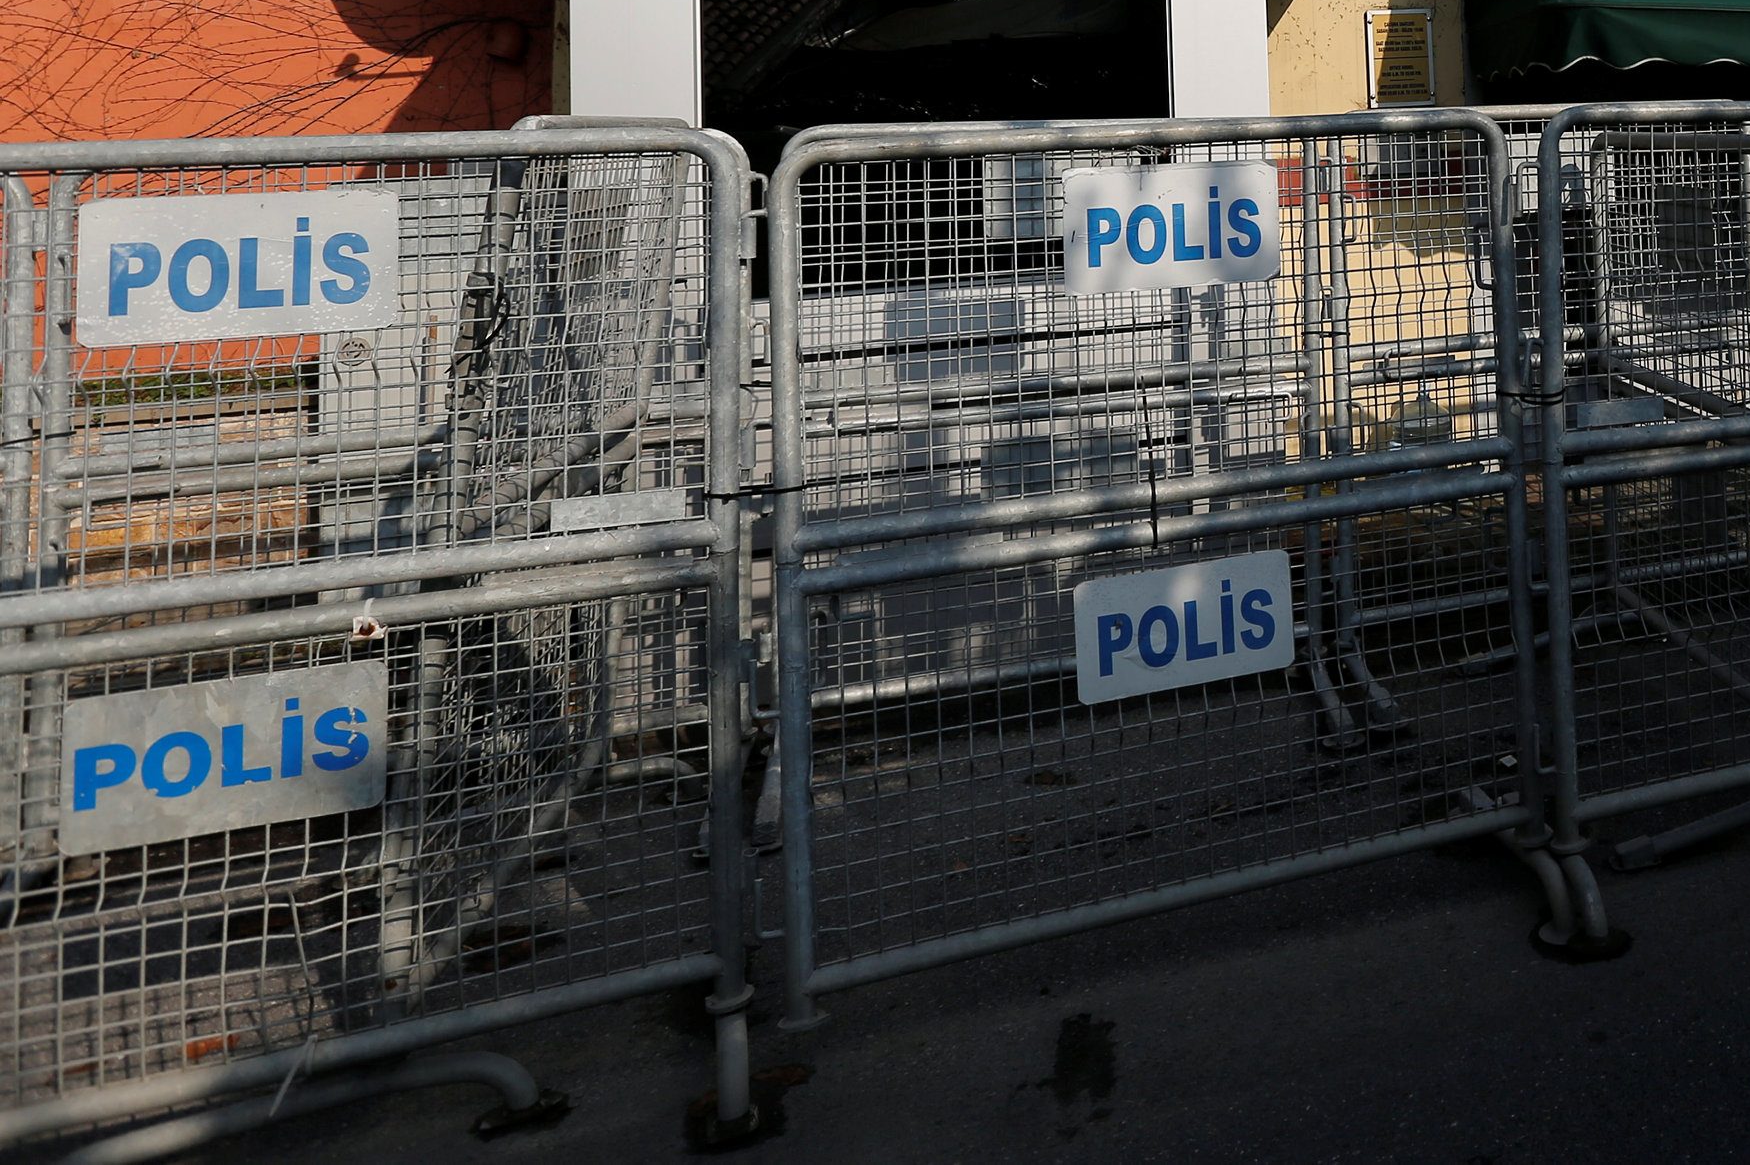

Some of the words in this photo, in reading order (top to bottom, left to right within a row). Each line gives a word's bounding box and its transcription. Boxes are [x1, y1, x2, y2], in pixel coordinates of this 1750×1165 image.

[108, 217, 370, 317] POLİS
[1087, 185, 1262, 268] POLİS
[1097, 579, 1276, 676] POLİS
[73, 698, 369, 812] POLİS
